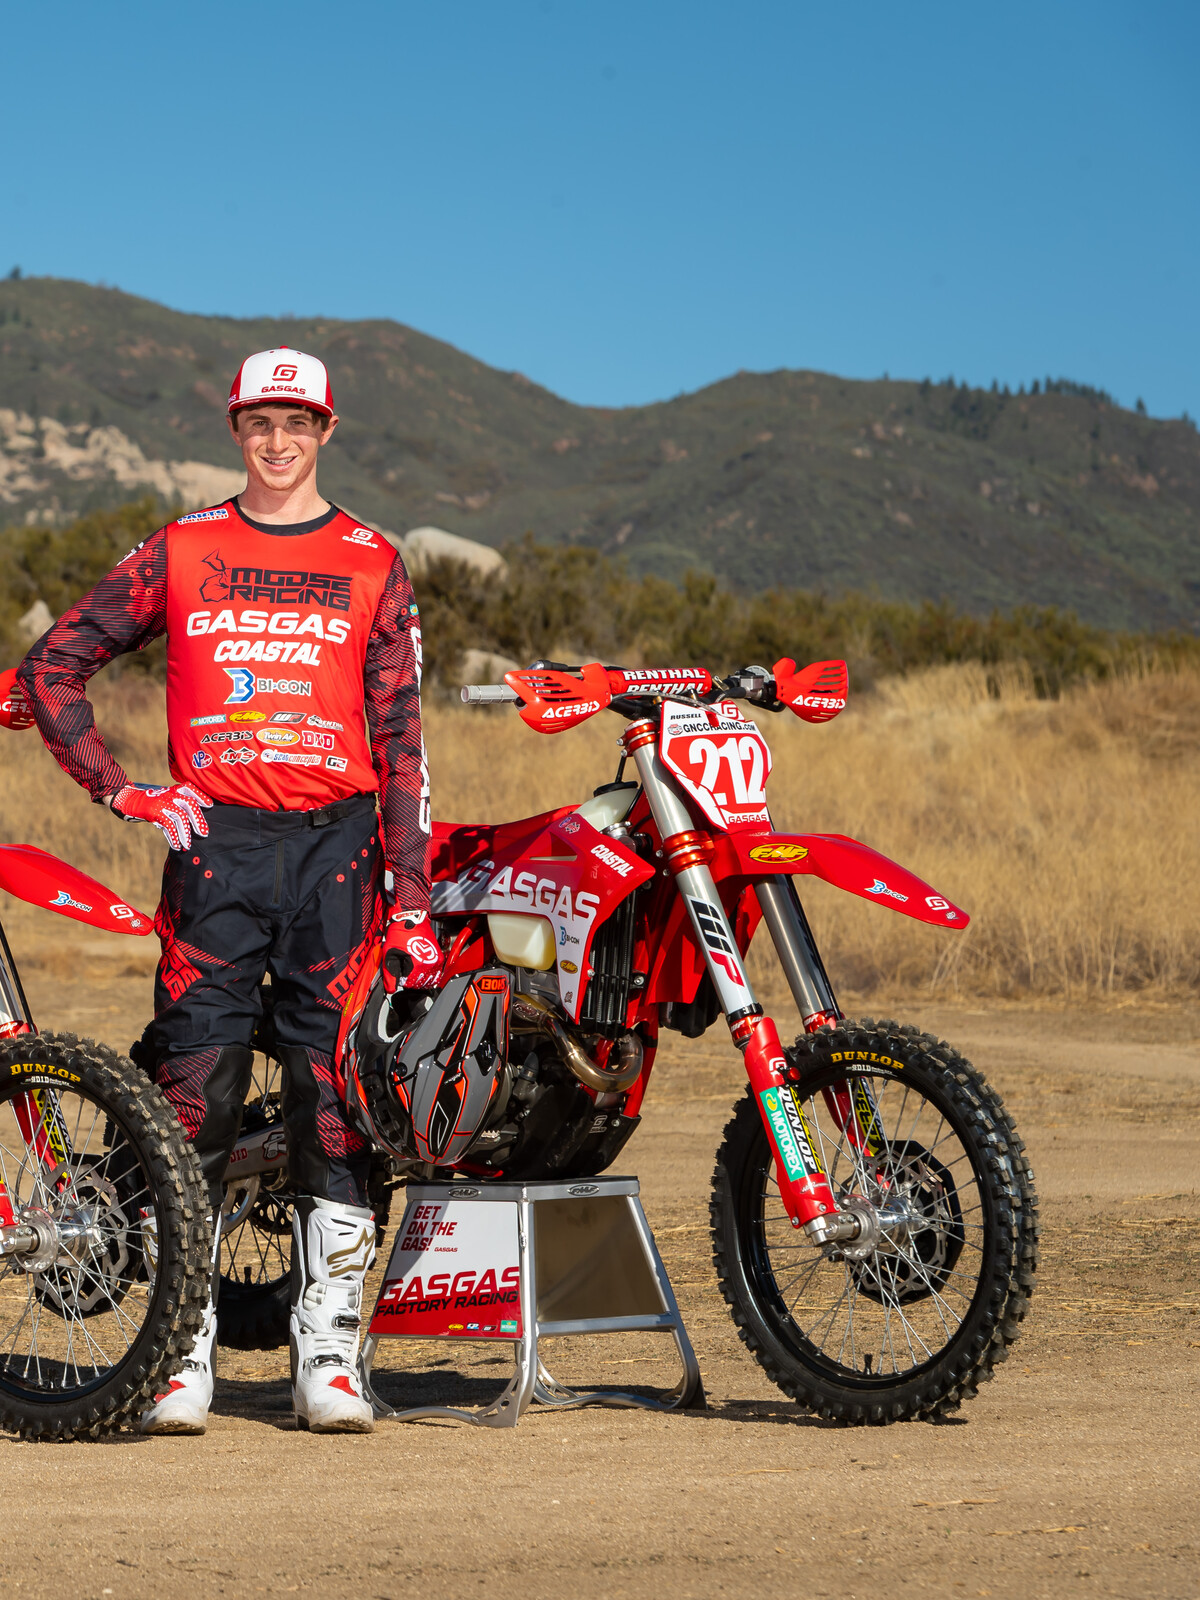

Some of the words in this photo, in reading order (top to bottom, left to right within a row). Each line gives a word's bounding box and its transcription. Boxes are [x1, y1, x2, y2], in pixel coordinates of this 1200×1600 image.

[261, 385, 306, 395] GASGAS
[178, 509, 226, 521] PARTS
[342, 535, 378, 549] GASGAS
[231, 568, 353, 592] MOOSE
[229, 585, 351, 612] RACING
[187, 609, 351, 644] GASGAS
[213, 640, 321, 666] COASTAL
[623, 669, 705, 681] RENTHAL
[199, 714, 225, 724] MOTOREX
[263, 731, 281, 741] Twin
[281, 732, 295, 742] Air
[223, 751, 253, 760] IMS
[689, 736, 767, 806] 212
[728, 814, 767, 823] GASGAS
[590, 844, 634, 878] COASTAL
[749, 843, 808, 860] FMF
[466, 859, 600, 921] GASGAS
[830, 1051, 905, 1070] DUNLOP
[10, 1063, 81, 1082] DUNLOP
[778, 1086, 818, 1173] DUNLOP
[770, 1110, 803, 1175] MOTOREX
[413, 1205, 442, 1220] GET
[406, 1222, 429, 1236] ON
[431, 1222, 458, 1236] THE
[400, 1237, 433, 1252] GAS!
[383, 1266, 520, 1301] GASGAS
[374, 1298, 450, 1318] FACTORY
[454, 1290, 519, 1310] RACING
